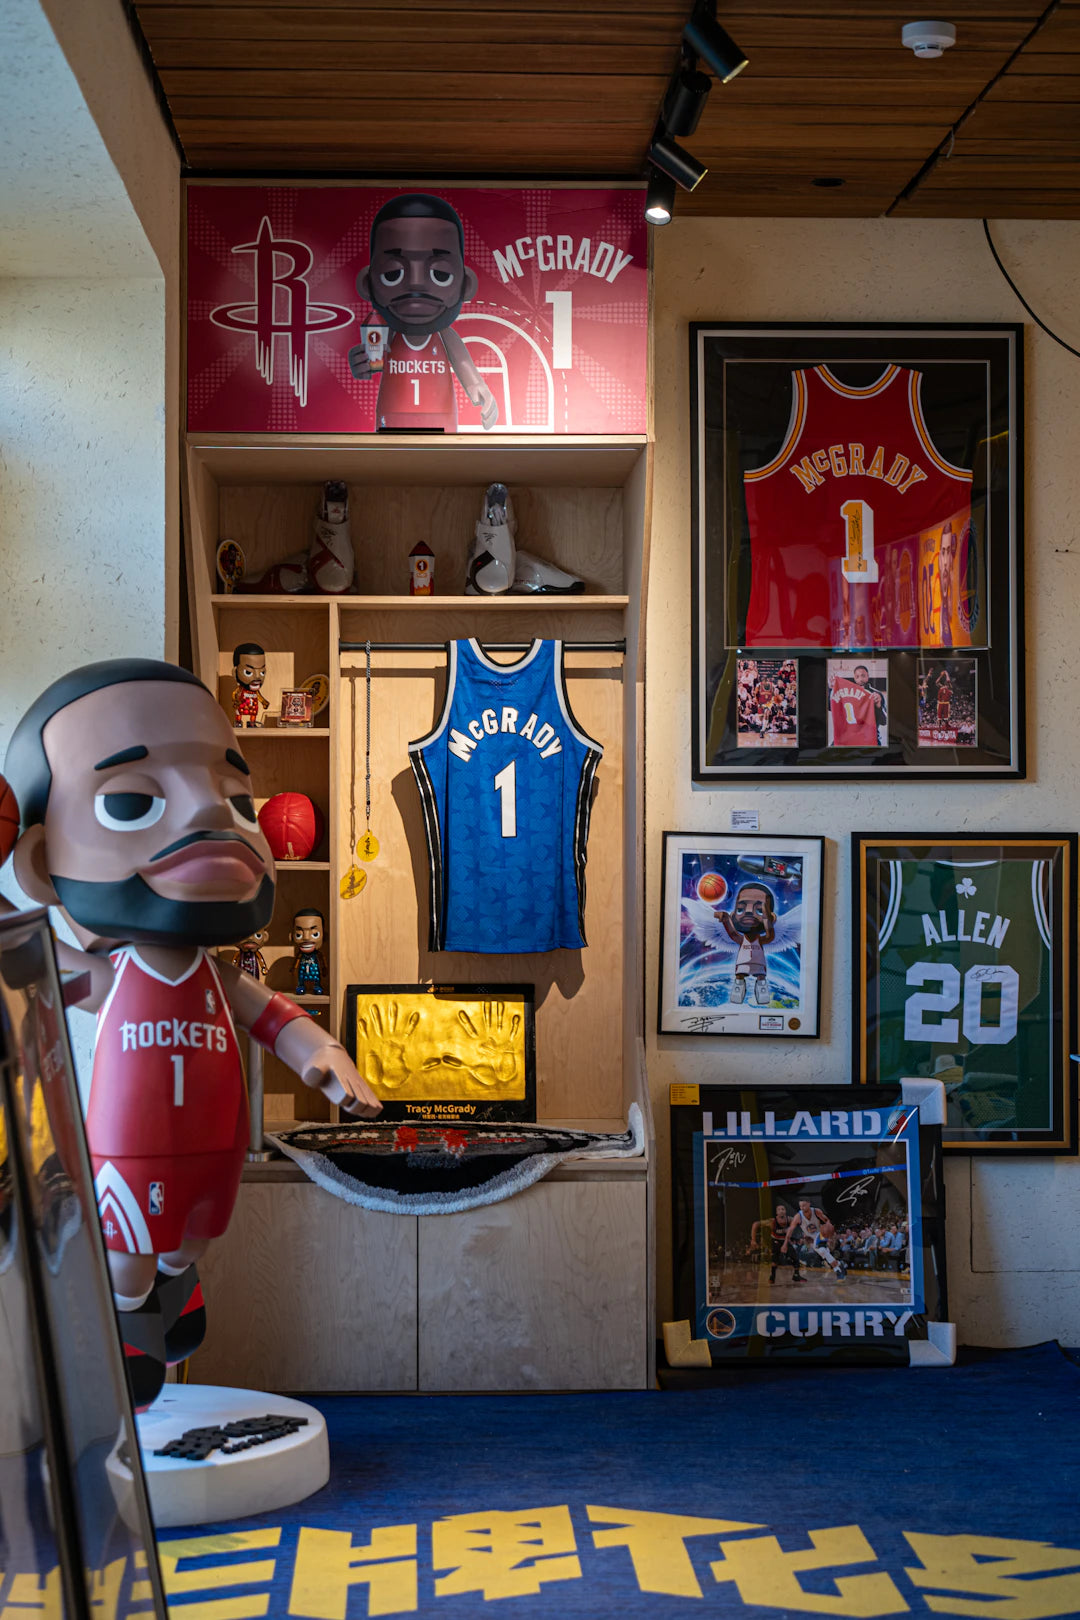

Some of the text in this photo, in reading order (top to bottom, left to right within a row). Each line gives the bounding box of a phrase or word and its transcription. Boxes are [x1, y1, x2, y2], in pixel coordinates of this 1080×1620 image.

[545, 291, 572, 369] 1
[388, 358, 446, 375] ROCKETS
[410, 379, 420, 406] 1
[840, 500, 879, 583] 1
[494, 759, 518, 838] 1
[921, 909, 1011, 949] ALLEN
[904, 962, 1020, 1045] 20
[119, 1018, 228, 1053] ROCKETS
[170, 1055, 184, 1107] 1
[406, 1103, 477, 1115] Tracy McGrady
[702, 1110, 882, 1136] LILLARD
[756, 1311, 914, 1337] CURRY
